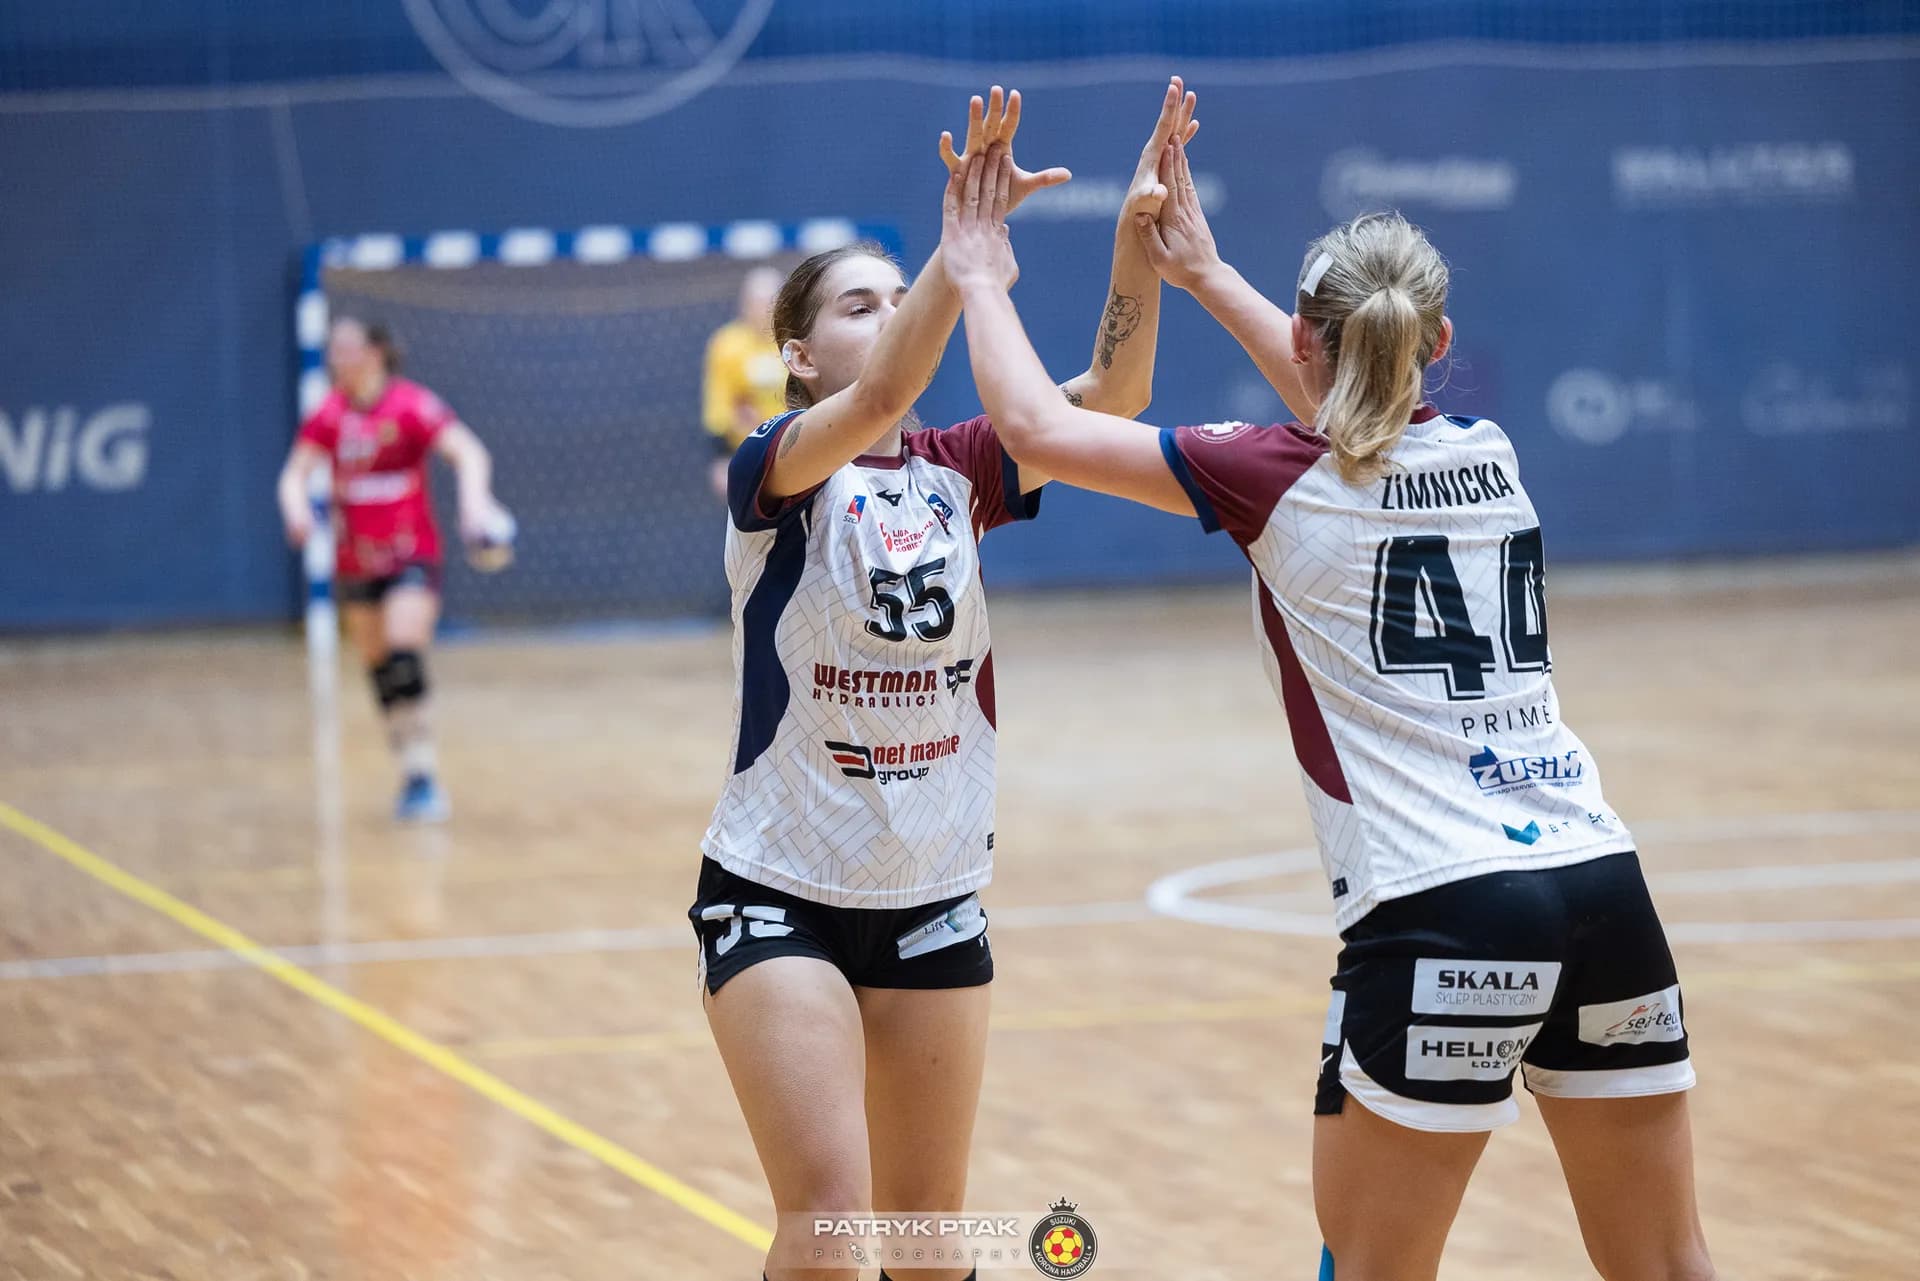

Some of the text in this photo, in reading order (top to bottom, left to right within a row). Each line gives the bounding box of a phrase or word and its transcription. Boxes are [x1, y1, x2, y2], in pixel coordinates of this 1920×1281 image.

[1381, 461, 1515, 510] ZIMNICKA
[864, 557, 955, 643] 55
[814, 662, 937, 693] WESTMAR
[812, 687, 936, 708] HYDRAULICS
[873, 734, 960, 765] net marine
[878, 766, 930, 785] group
[1437, 970, 1539, 990] SKALA
[1435, 991, 1537, 1006] SKLEP PLASTYCZNY
